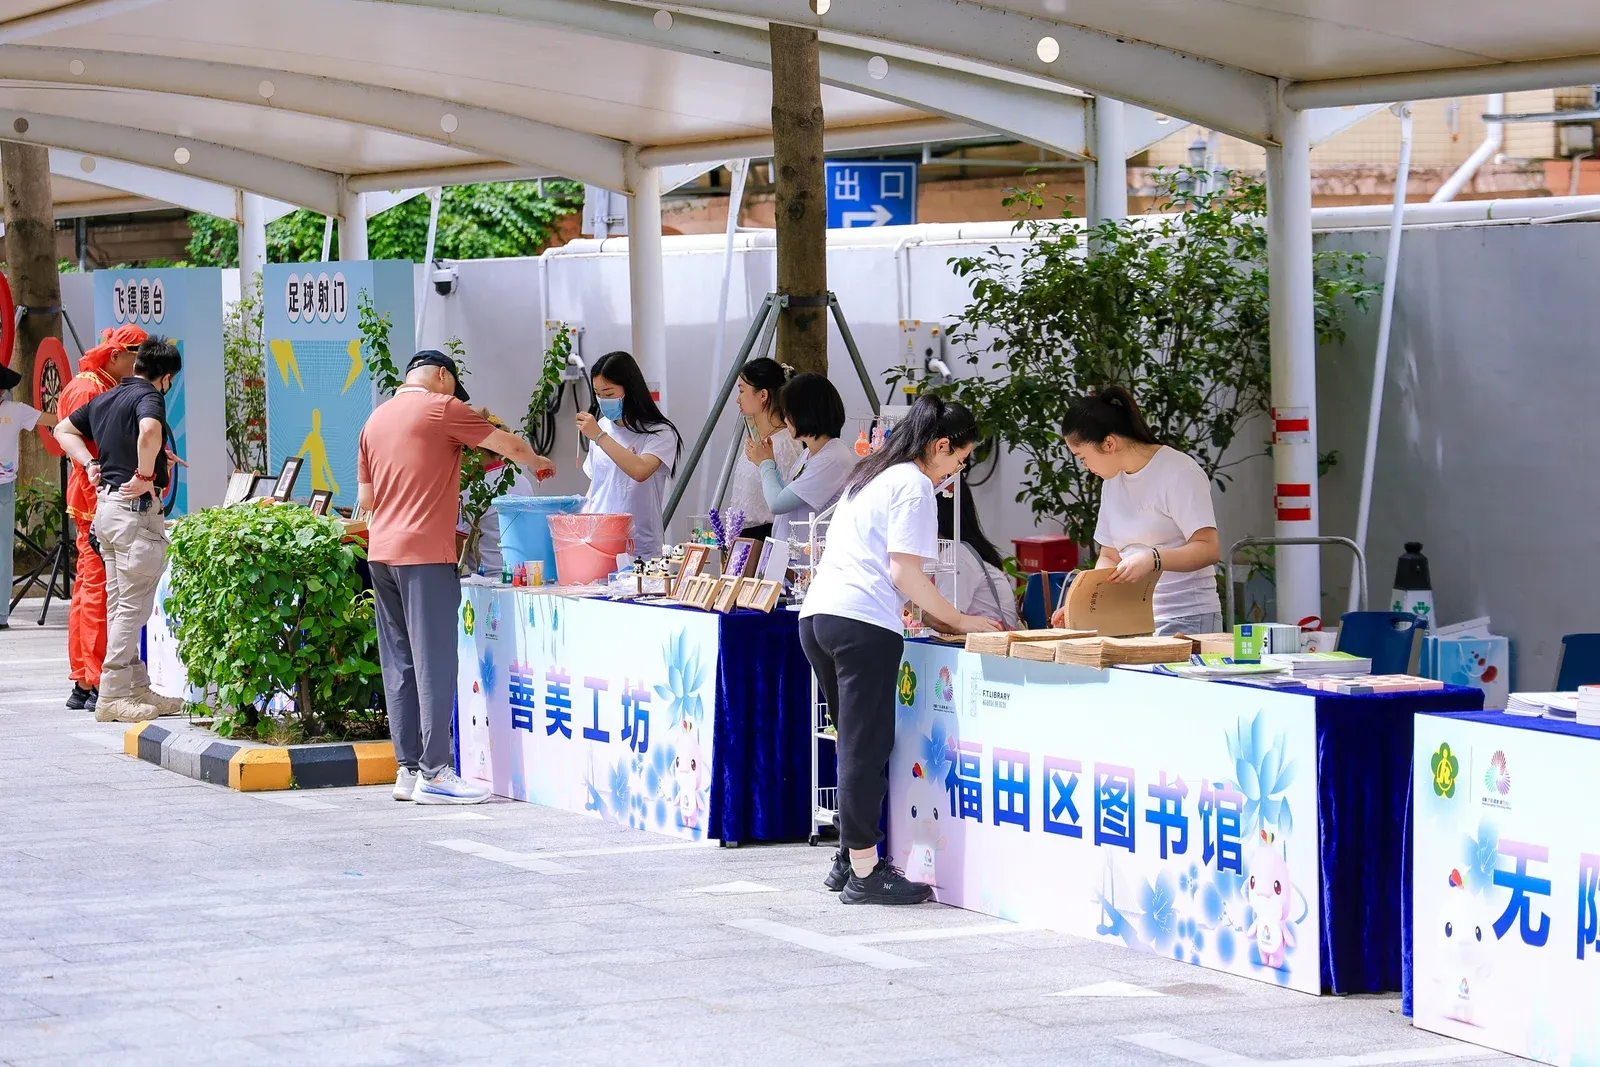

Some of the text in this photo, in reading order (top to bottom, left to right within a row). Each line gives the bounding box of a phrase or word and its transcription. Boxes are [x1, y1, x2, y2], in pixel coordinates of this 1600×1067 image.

[835, 168, 904, 201] 出口
[115, 285, 162, 315] 飞镖擂台
[289, 280, 345, 313] 足球射门
[509, 658, 651, 753] 善美工坊
[944, 735, 1244, 876] 福田区图书馆
